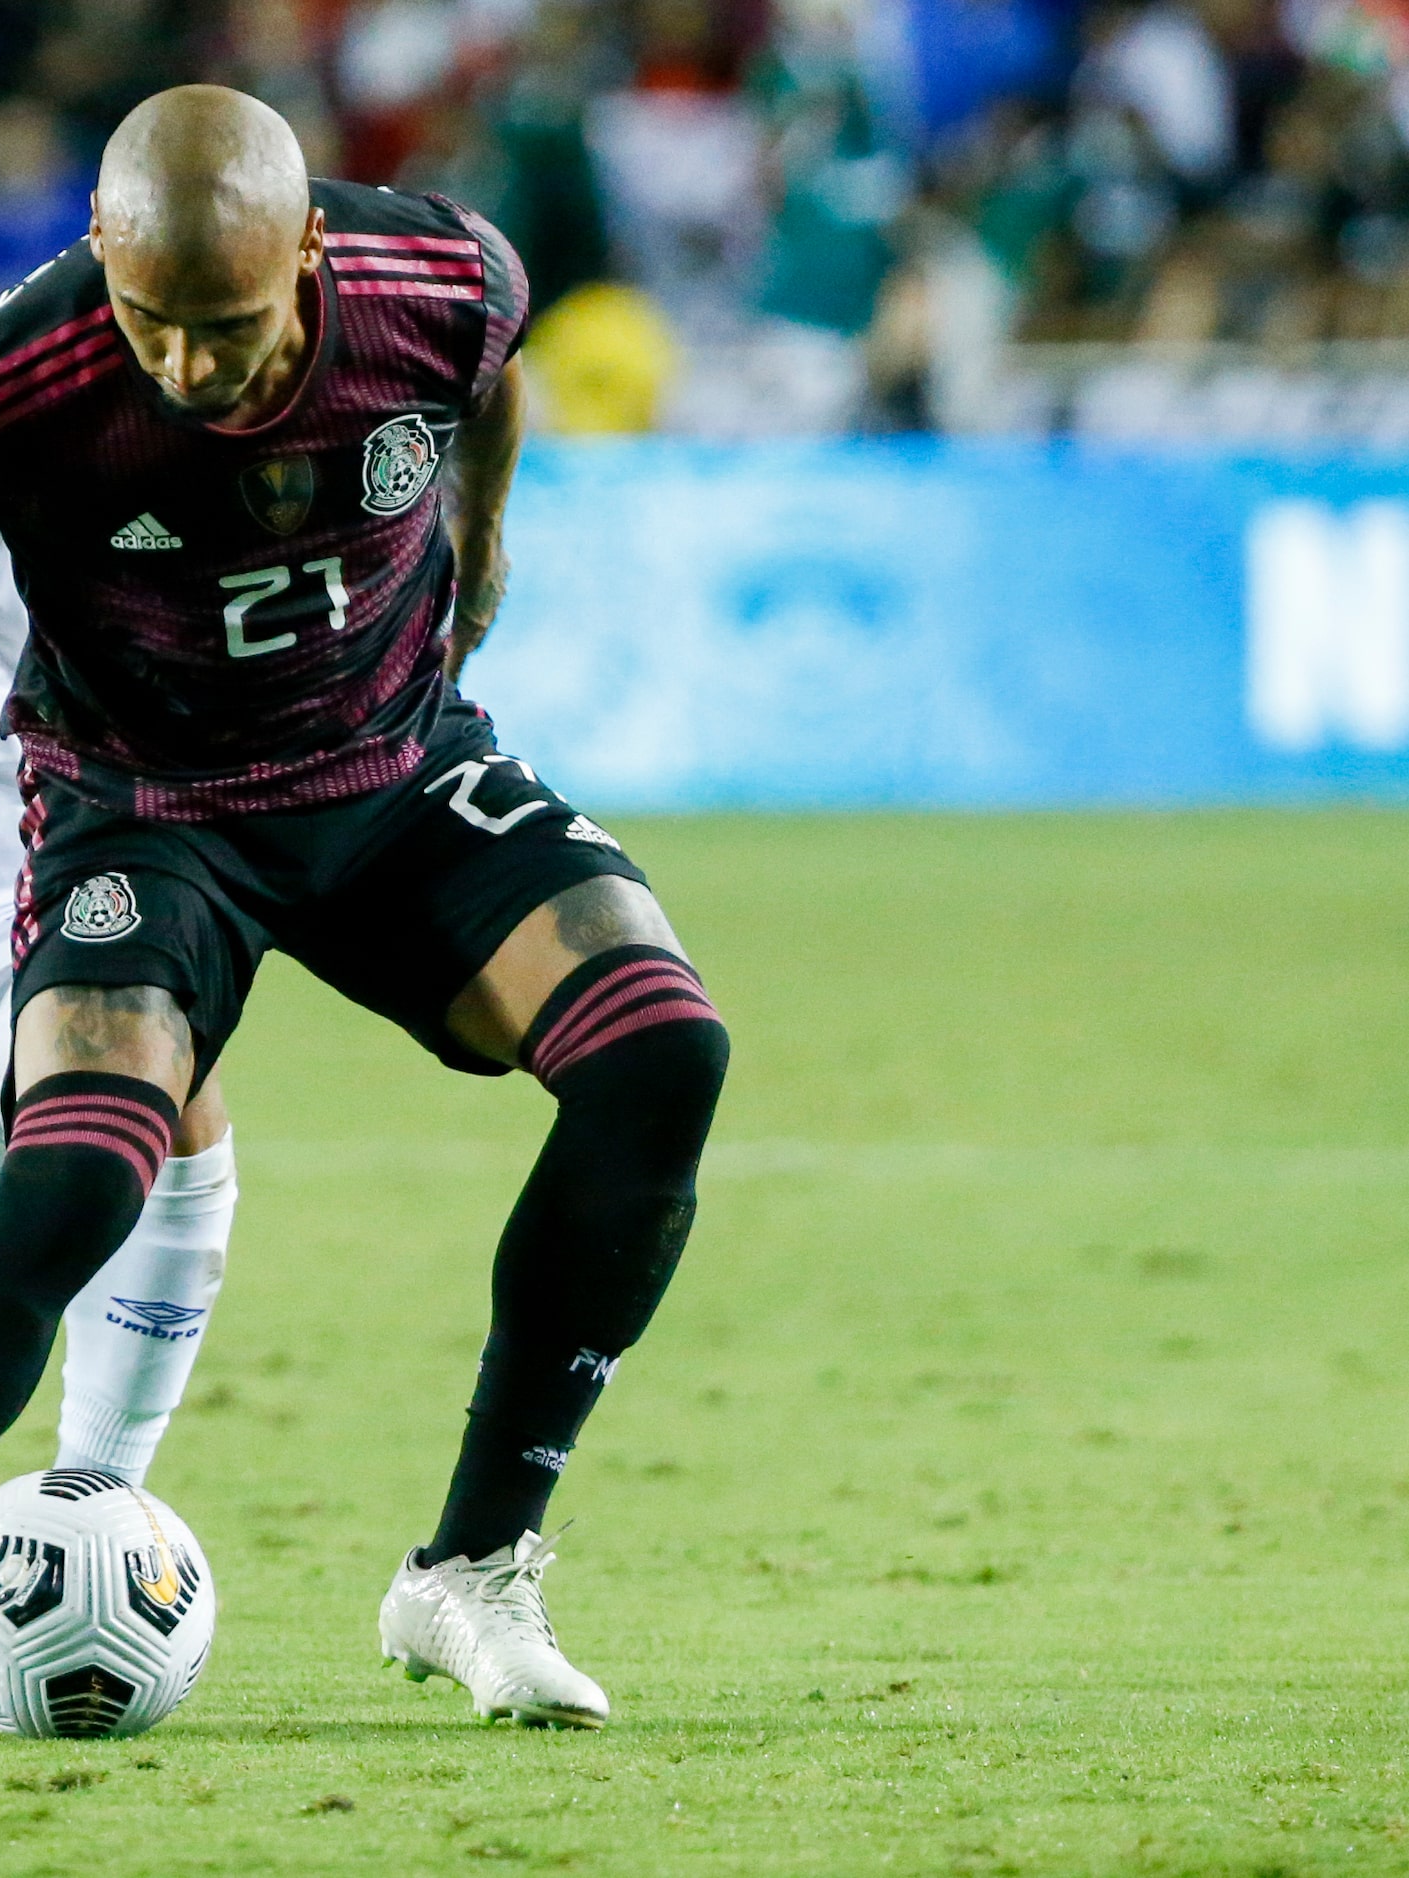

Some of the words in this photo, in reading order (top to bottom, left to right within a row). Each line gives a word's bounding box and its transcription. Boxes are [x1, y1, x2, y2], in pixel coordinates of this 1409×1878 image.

[110, 535, 184, 550] adidas
[218, 556, 350, 658] 21
[106, 1311, 199, 1341] umbro
